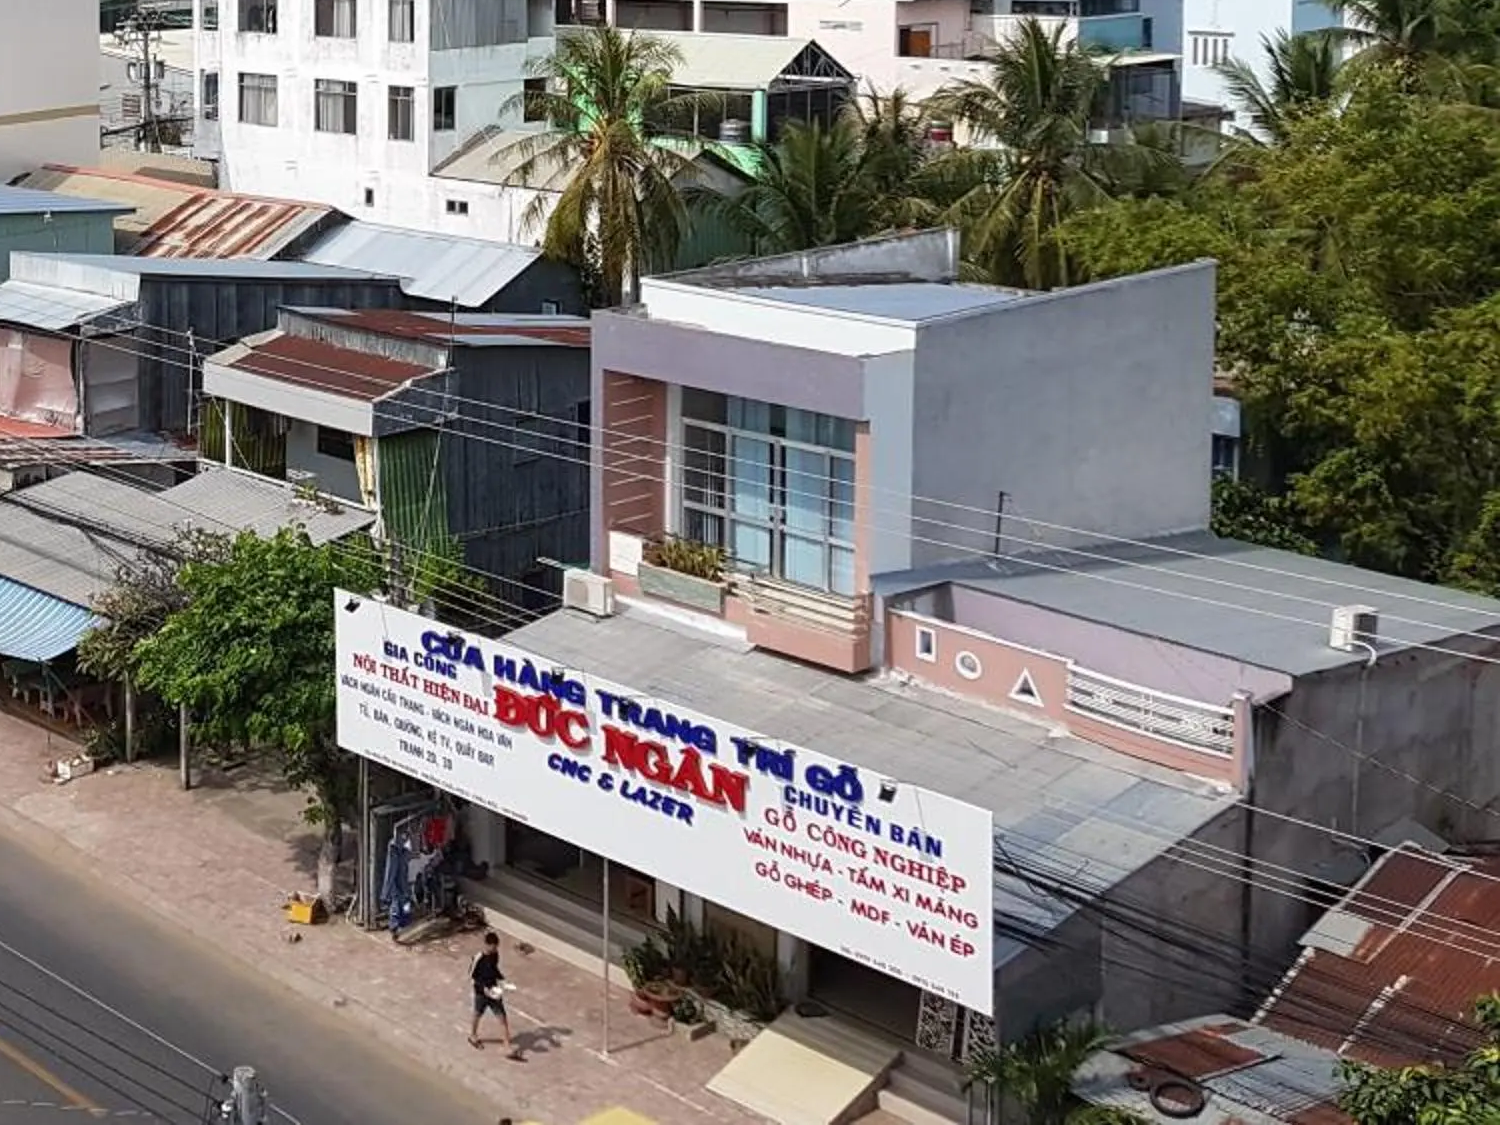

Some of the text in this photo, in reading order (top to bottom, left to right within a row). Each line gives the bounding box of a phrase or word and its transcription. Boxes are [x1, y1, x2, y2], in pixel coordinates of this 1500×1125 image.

[353, 652, 376, 675] NỘI
[381, 663, 419, 690] THẤT
[423, 679, 460, 704] HIỆN
[384, 640, 457, 680] GIA CÔNG
[493, 654, 586, 707] HÀNG
[596, 690, 717, 755] TRANG
[729, 736, 796, 783] TRÍ
[805, 764, 864, 803] GỖ
[493, 683, 591, 749] ĐỨC
[602, 725, 749, 812] NGÂN
[548, 753, 592, 783] CNC
[620, 780, 694, 826] LAZER
[784, 785, 943, 858] CHUYÊN BÁN
[765, 805, 967, 894] GỖ CÔNG NGHIỆP
[781, 841, 834, 875] NHỰA
[847, 865, 886, 896] TẤM
[892, 883, 909, 903] XI
[916, 893, 979, 930] MĂNG
[755, 860, 781, 882] GỖ
[784, 874, 833, 901] GHÉP
[850, 899, 890, 926] MDF
[906, 920, 944, 948] VÁN
[950, 933, 975, 956] ÉP
